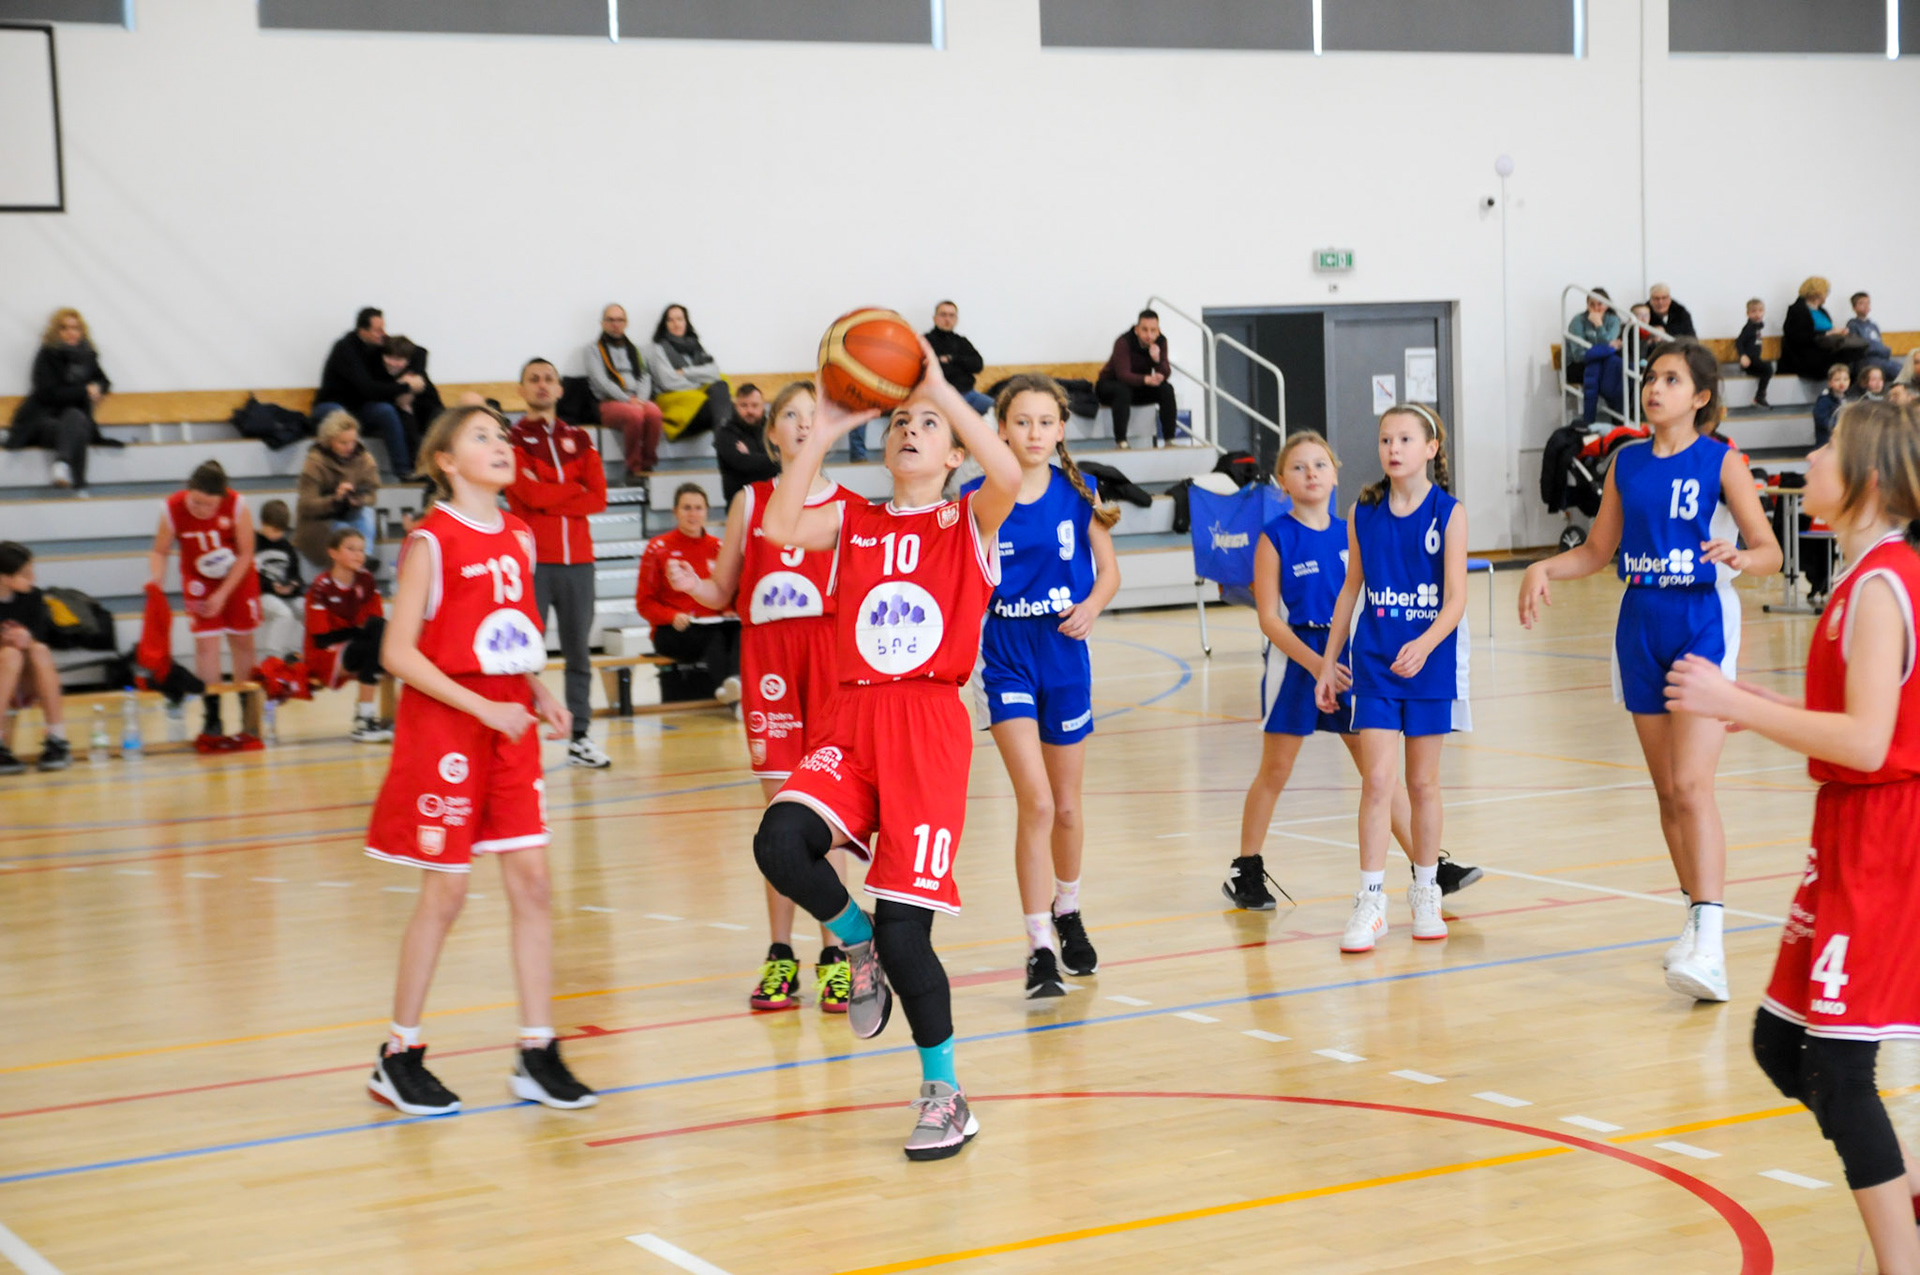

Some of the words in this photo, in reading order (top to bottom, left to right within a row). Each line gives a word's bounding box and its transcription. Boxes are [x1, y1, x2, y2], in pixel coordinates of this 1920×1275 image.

[1669, 478, 1700, 520] 13
[850, 534, 877, 548] JAKO
[1057, 519, 1075, 560] 9
[1425, 517, 1441, 555] 6
[880, 532, 921, 576] 10
[1623, 552, 1669, 574] huber
[486, 554, 523, 604] 13
[1658, 575, 1696, 588] group
[994, 597, 1051, 618] huber
[1367, 586, 1417, 607] huber
[1405, 608, 1439, 621] group
[913, 824, 952, 879] 10
[912, 877, 939, 891] JAKO
[1810, 934, 1850, 999] 4
